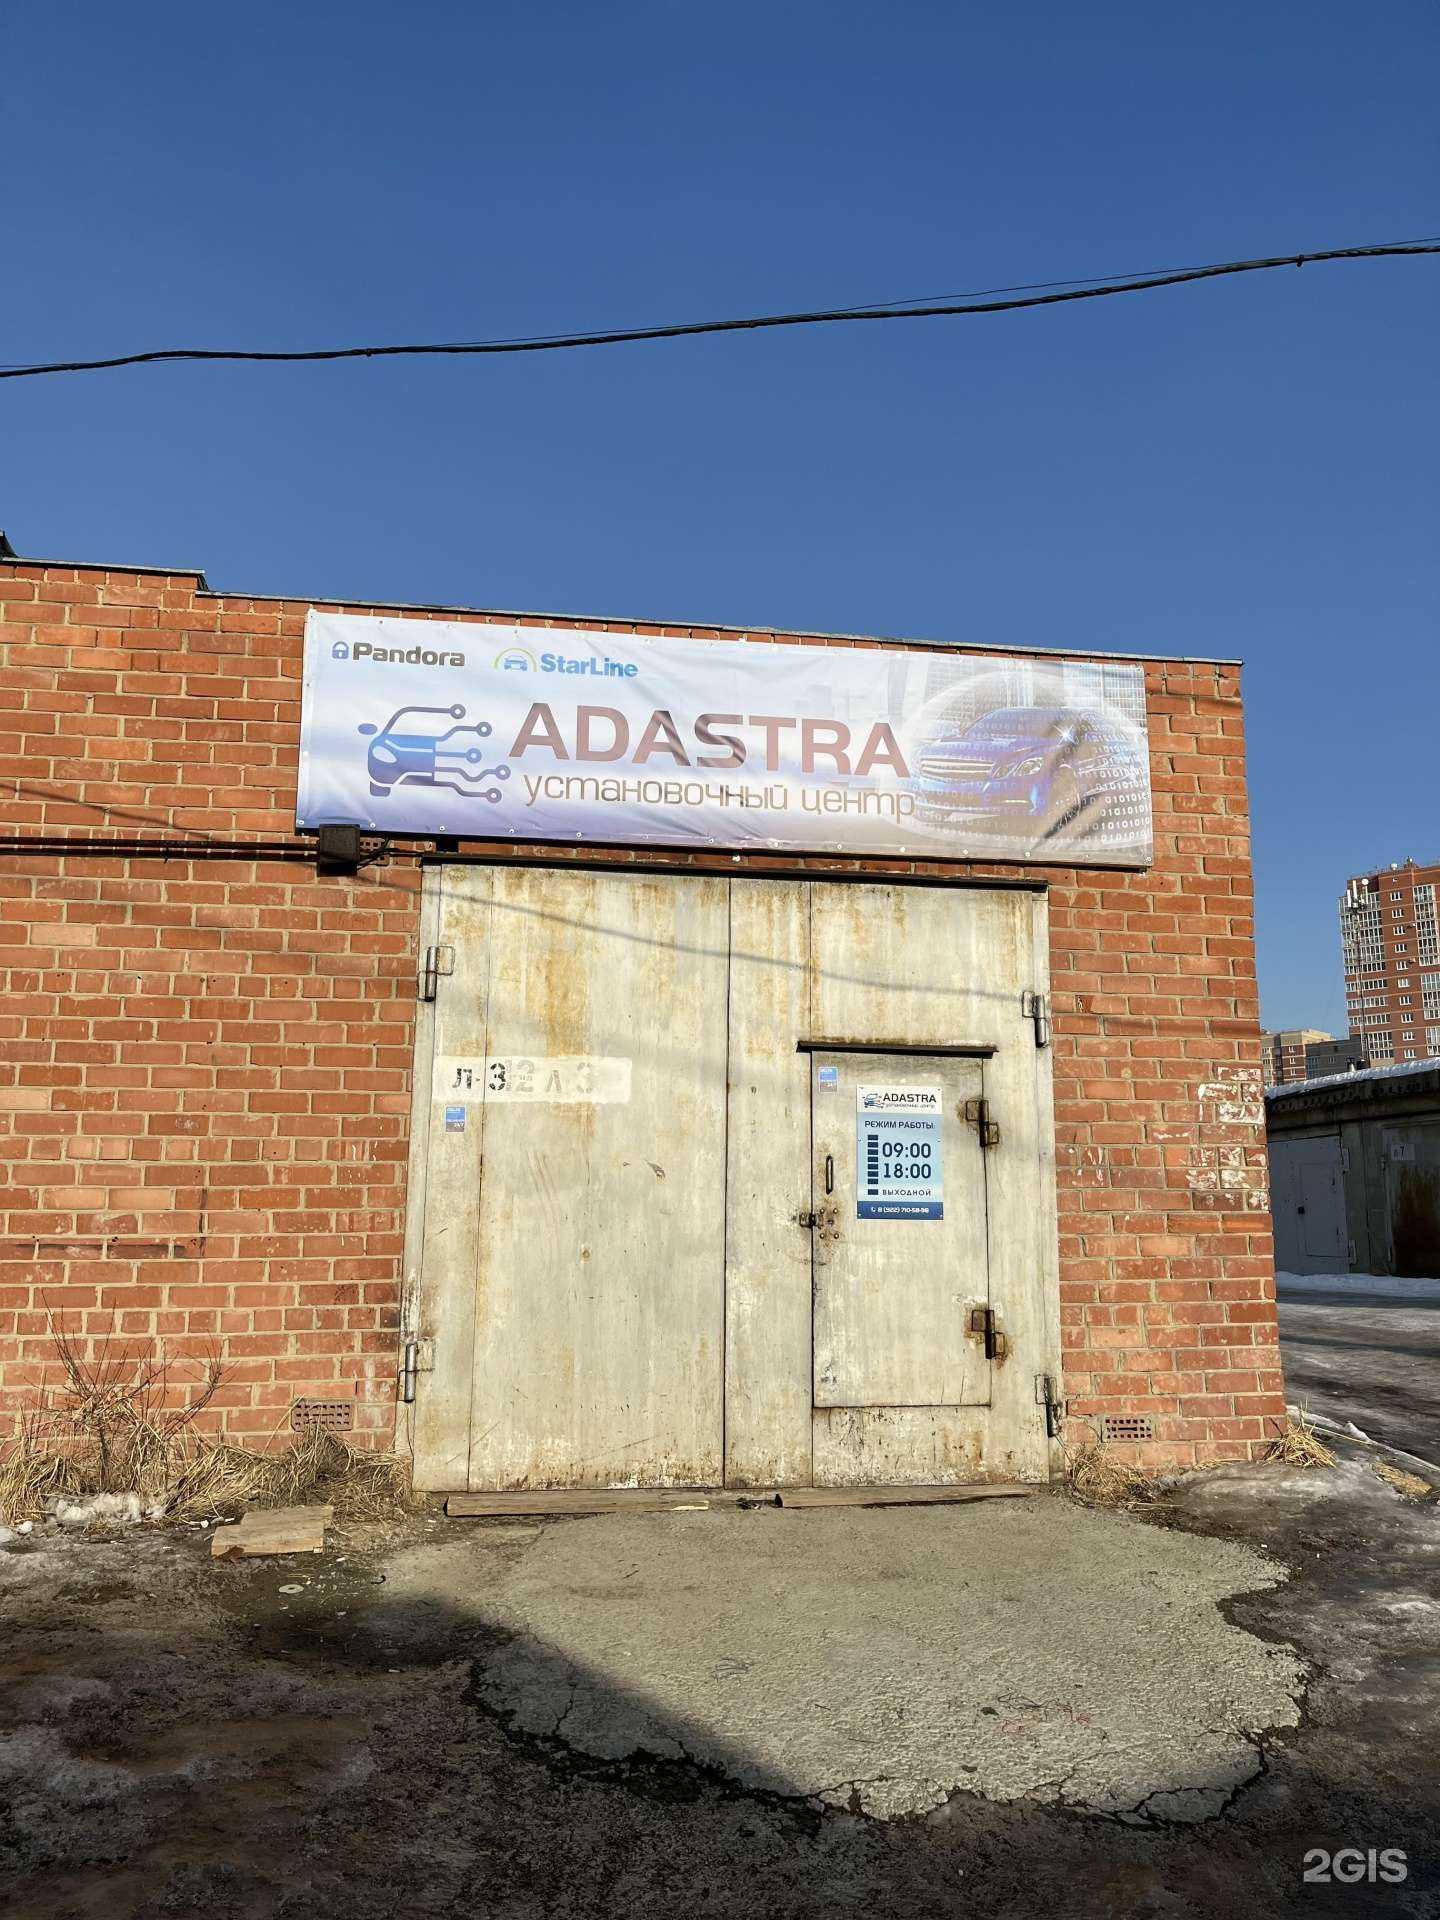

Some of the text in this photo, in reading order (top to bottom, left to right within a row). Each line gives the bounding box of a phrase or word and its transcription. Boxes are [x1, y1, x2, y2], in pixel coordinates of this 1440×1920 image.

[352, 642, 465, 667] Pandora
[540, 653, 639, 678] StarLine
[508, 702, 912, 778] ADASTRA
[523, 773, 788, 810] установочный
[801, 788, 916, 824] центр
[883, 1092, 937, 1103] ADASTRA
[864, 1120, 897, 1129] РЕЖИМ
[882, 1142, 932, 1159] 09:00
[882, 1162, 932, 1179] 18:00
[882, 1188, 931, 1197] ВЫХОДНОЙ
